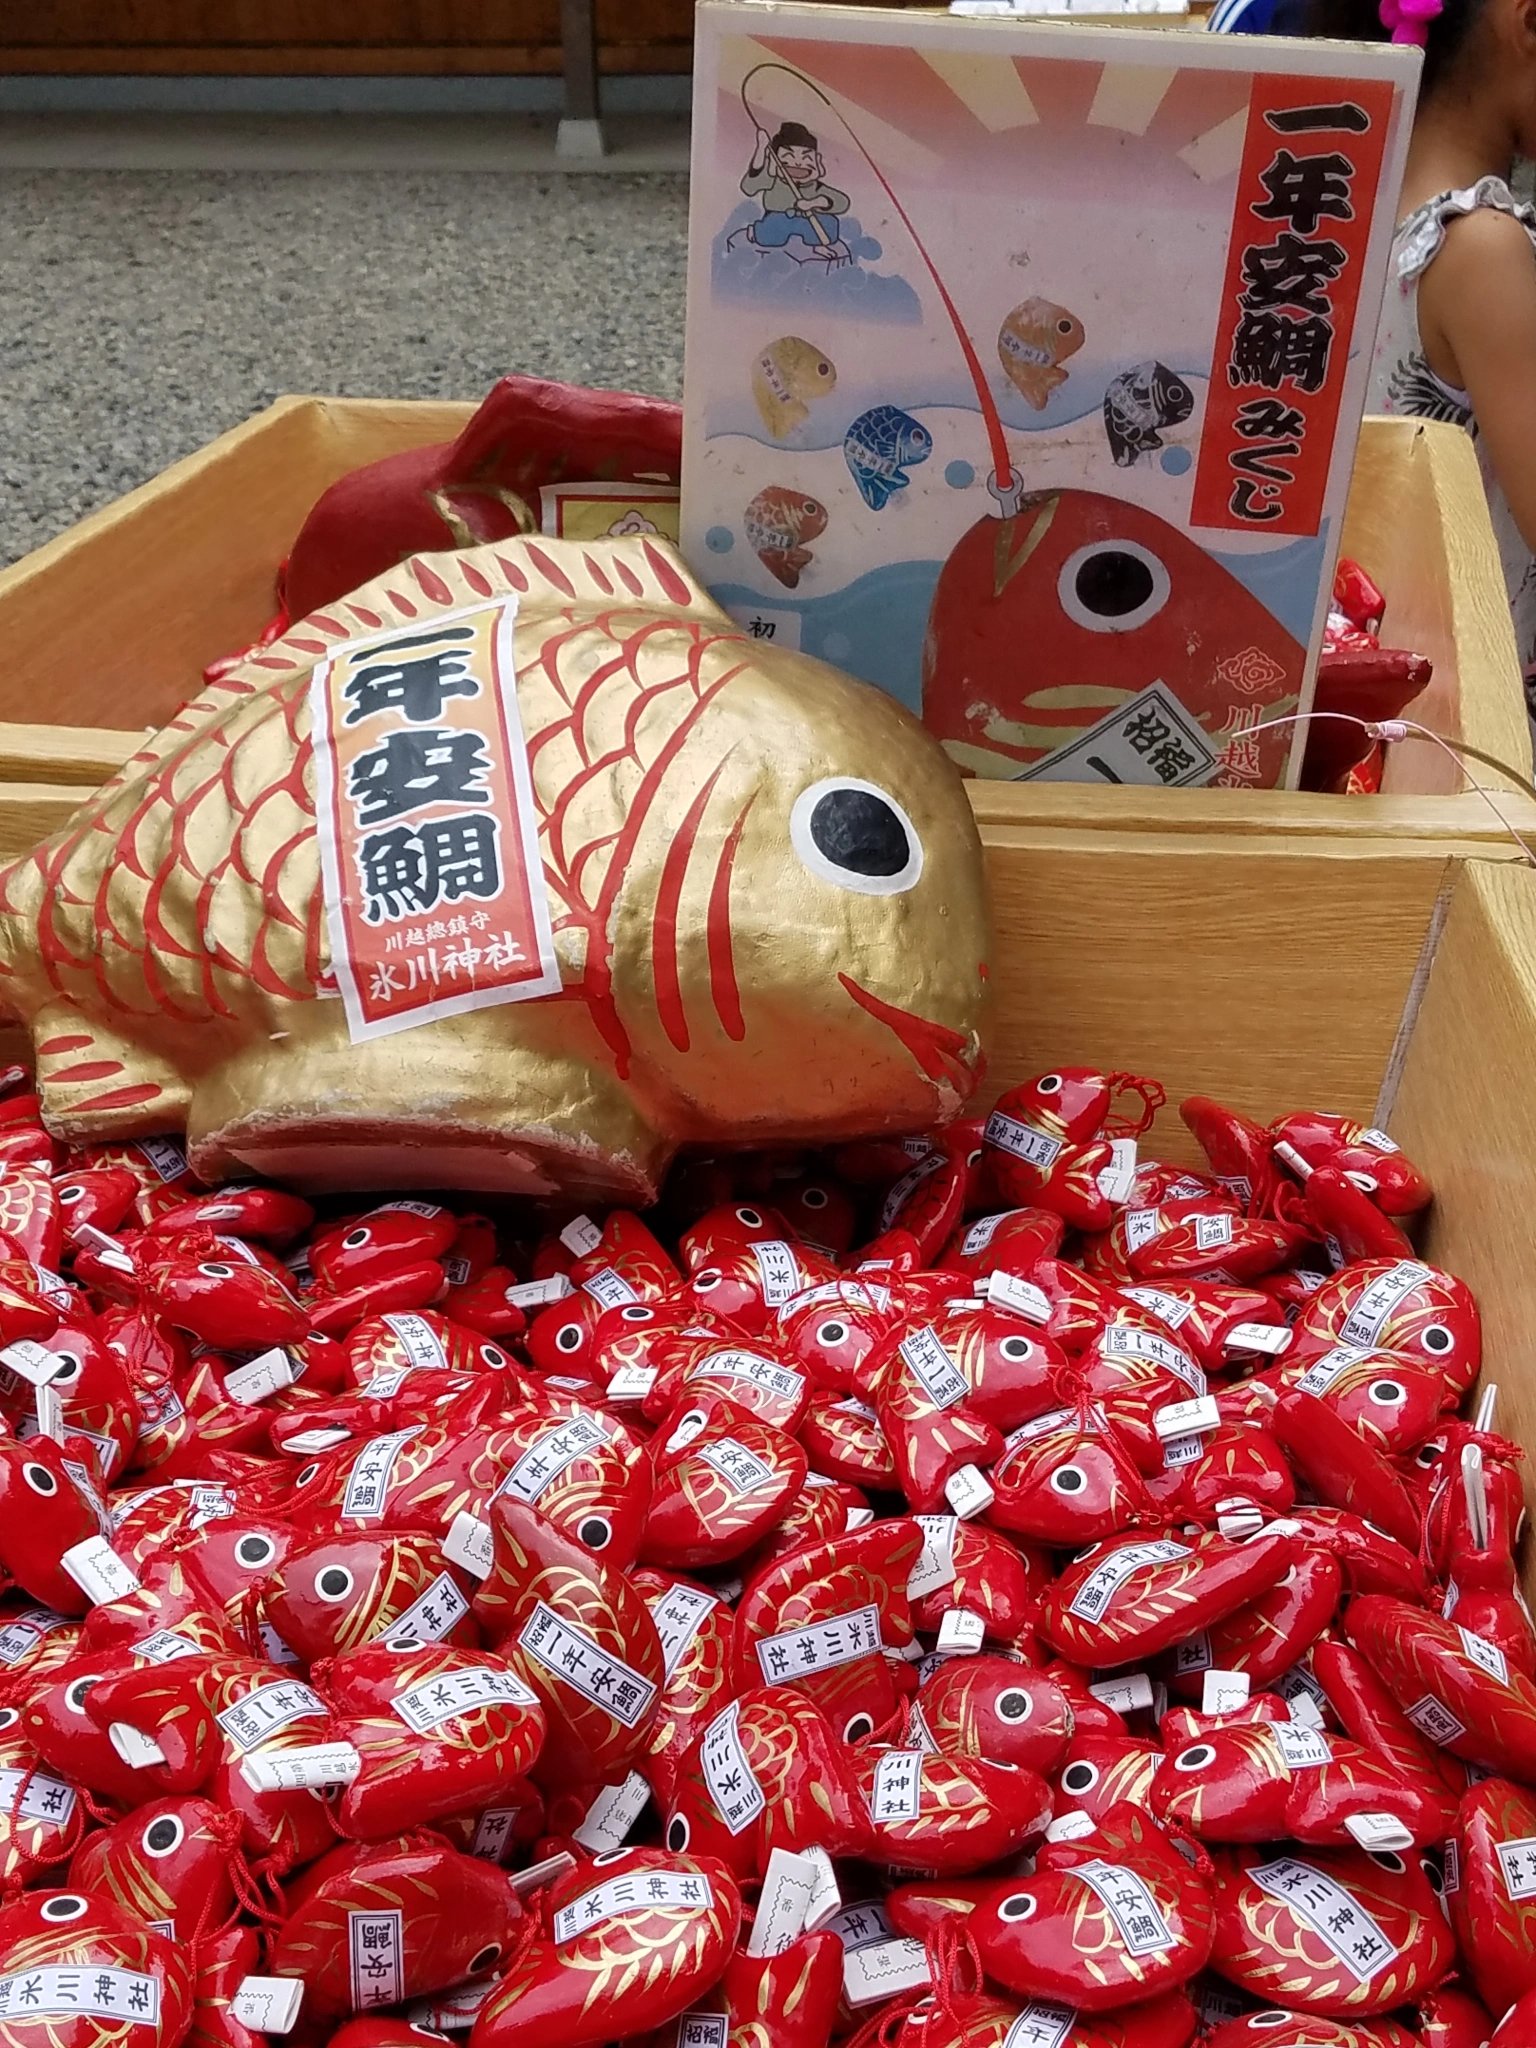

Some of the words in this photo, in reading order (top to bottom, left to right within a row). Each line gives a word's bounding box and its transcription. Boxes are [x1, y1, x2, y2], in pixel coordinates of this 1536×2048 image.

[1230, 103, 1369, 521] 一年安鯛みくじ
[747, 615, 776, 638] 初
[344, 627, 499, 923] 一年安鯛
[368, 930, 526, 1003] 氷川神社
[511, 1423, 599, 1495] 一年安鯛
[546, 1630, 642, 1714] 一年安鯛
[767, 1621, 863, 1677] 氷川神社
[429, 1673, 523, 1708] 氷川神社
[583, 1877, 702, 1919] 氷川神社
[1281, 1871, 1383, 1962] 氷川神社
[19, 1974, 150, 2012] 氷川神社
[686, 2022, 719, 2046] 招福
